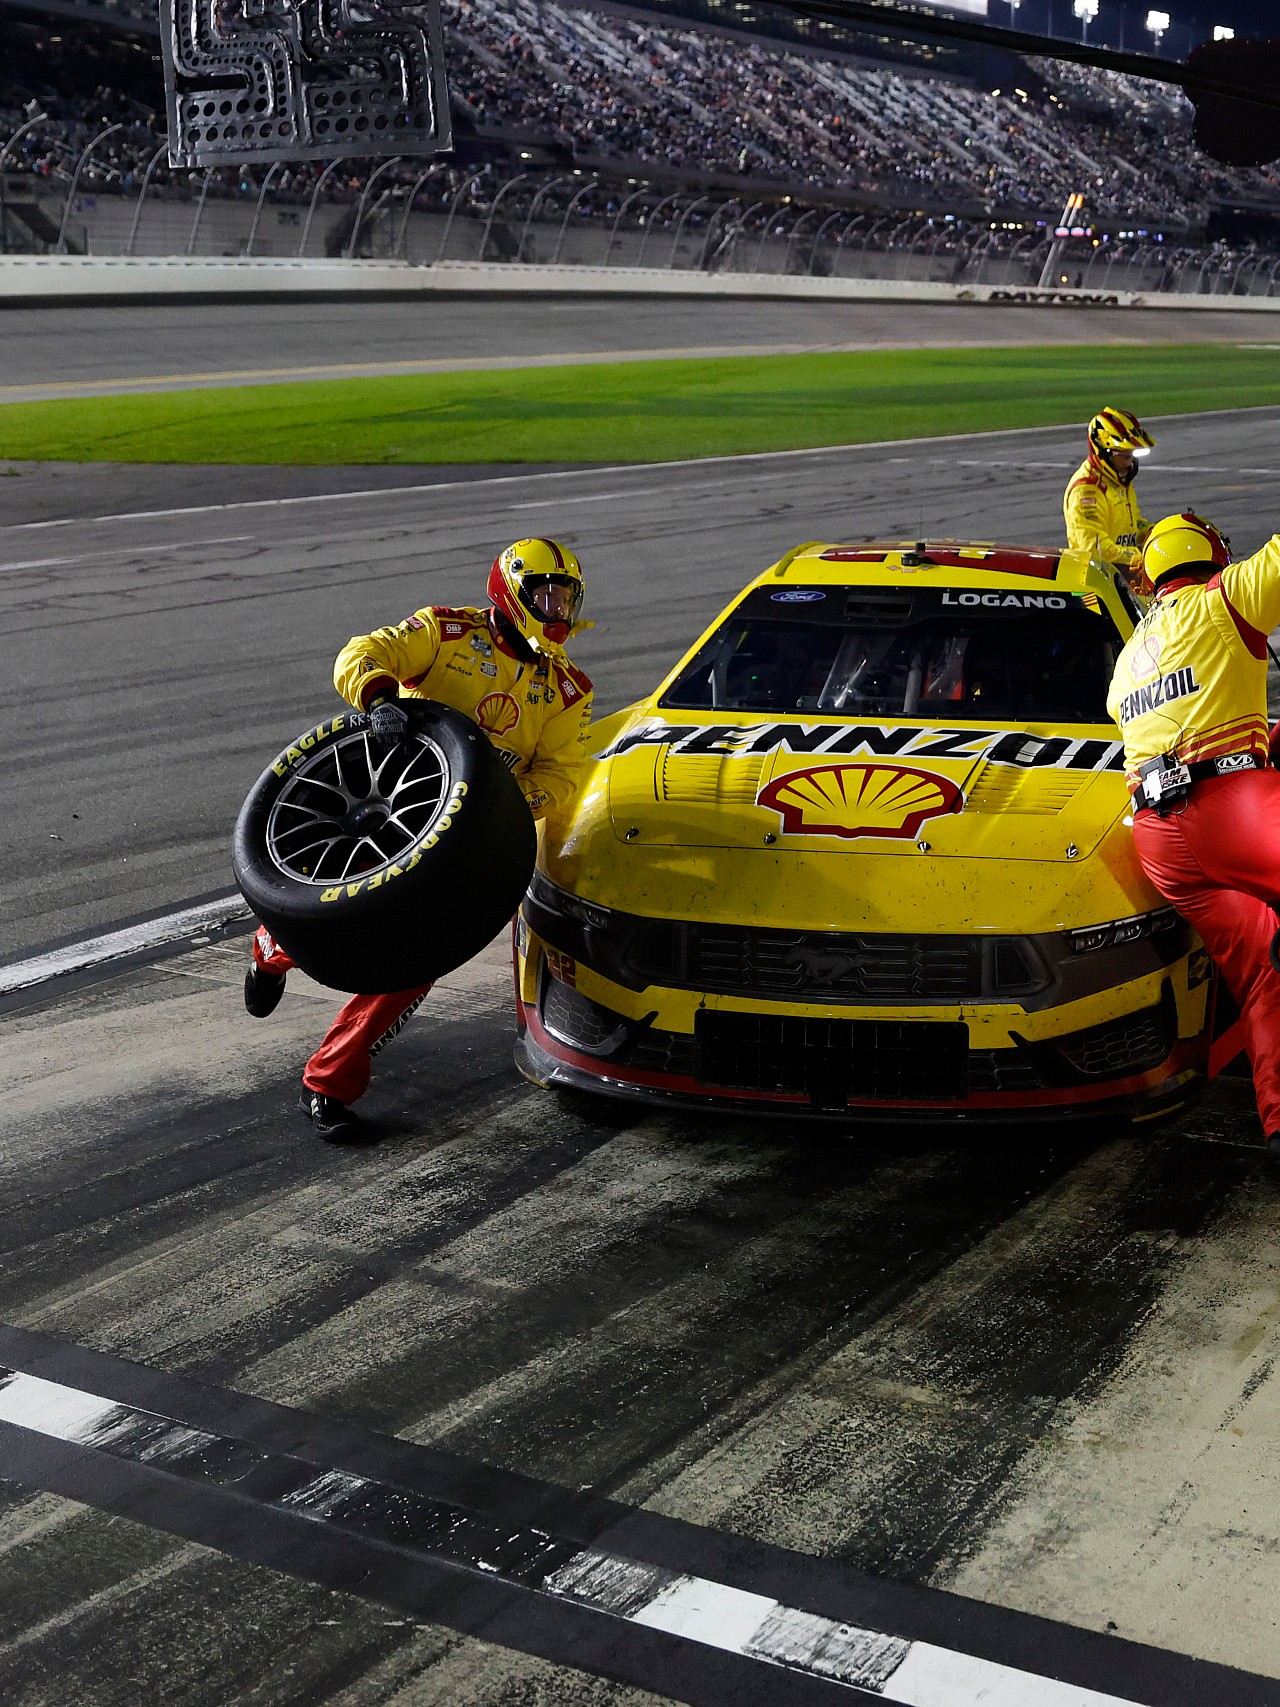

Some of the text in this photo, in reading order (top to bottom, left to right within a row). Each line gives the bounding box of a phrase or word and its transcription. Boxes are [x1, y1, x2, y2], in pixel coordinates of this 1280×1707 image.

[989, 290, 1119, 306] DAYTONA
[775, 591, 820, 602] Ford
[941, 592, 1067, 610] LOGANO
[445, 623, 462, 634] OMP
[1119, 665, 1202, 724] PENNZOIL
[272, 713, 346, 778] EAGLE
[1159, 767, 1182, 780] EAM
[320, 781, 469, 903] GOODYEAR
